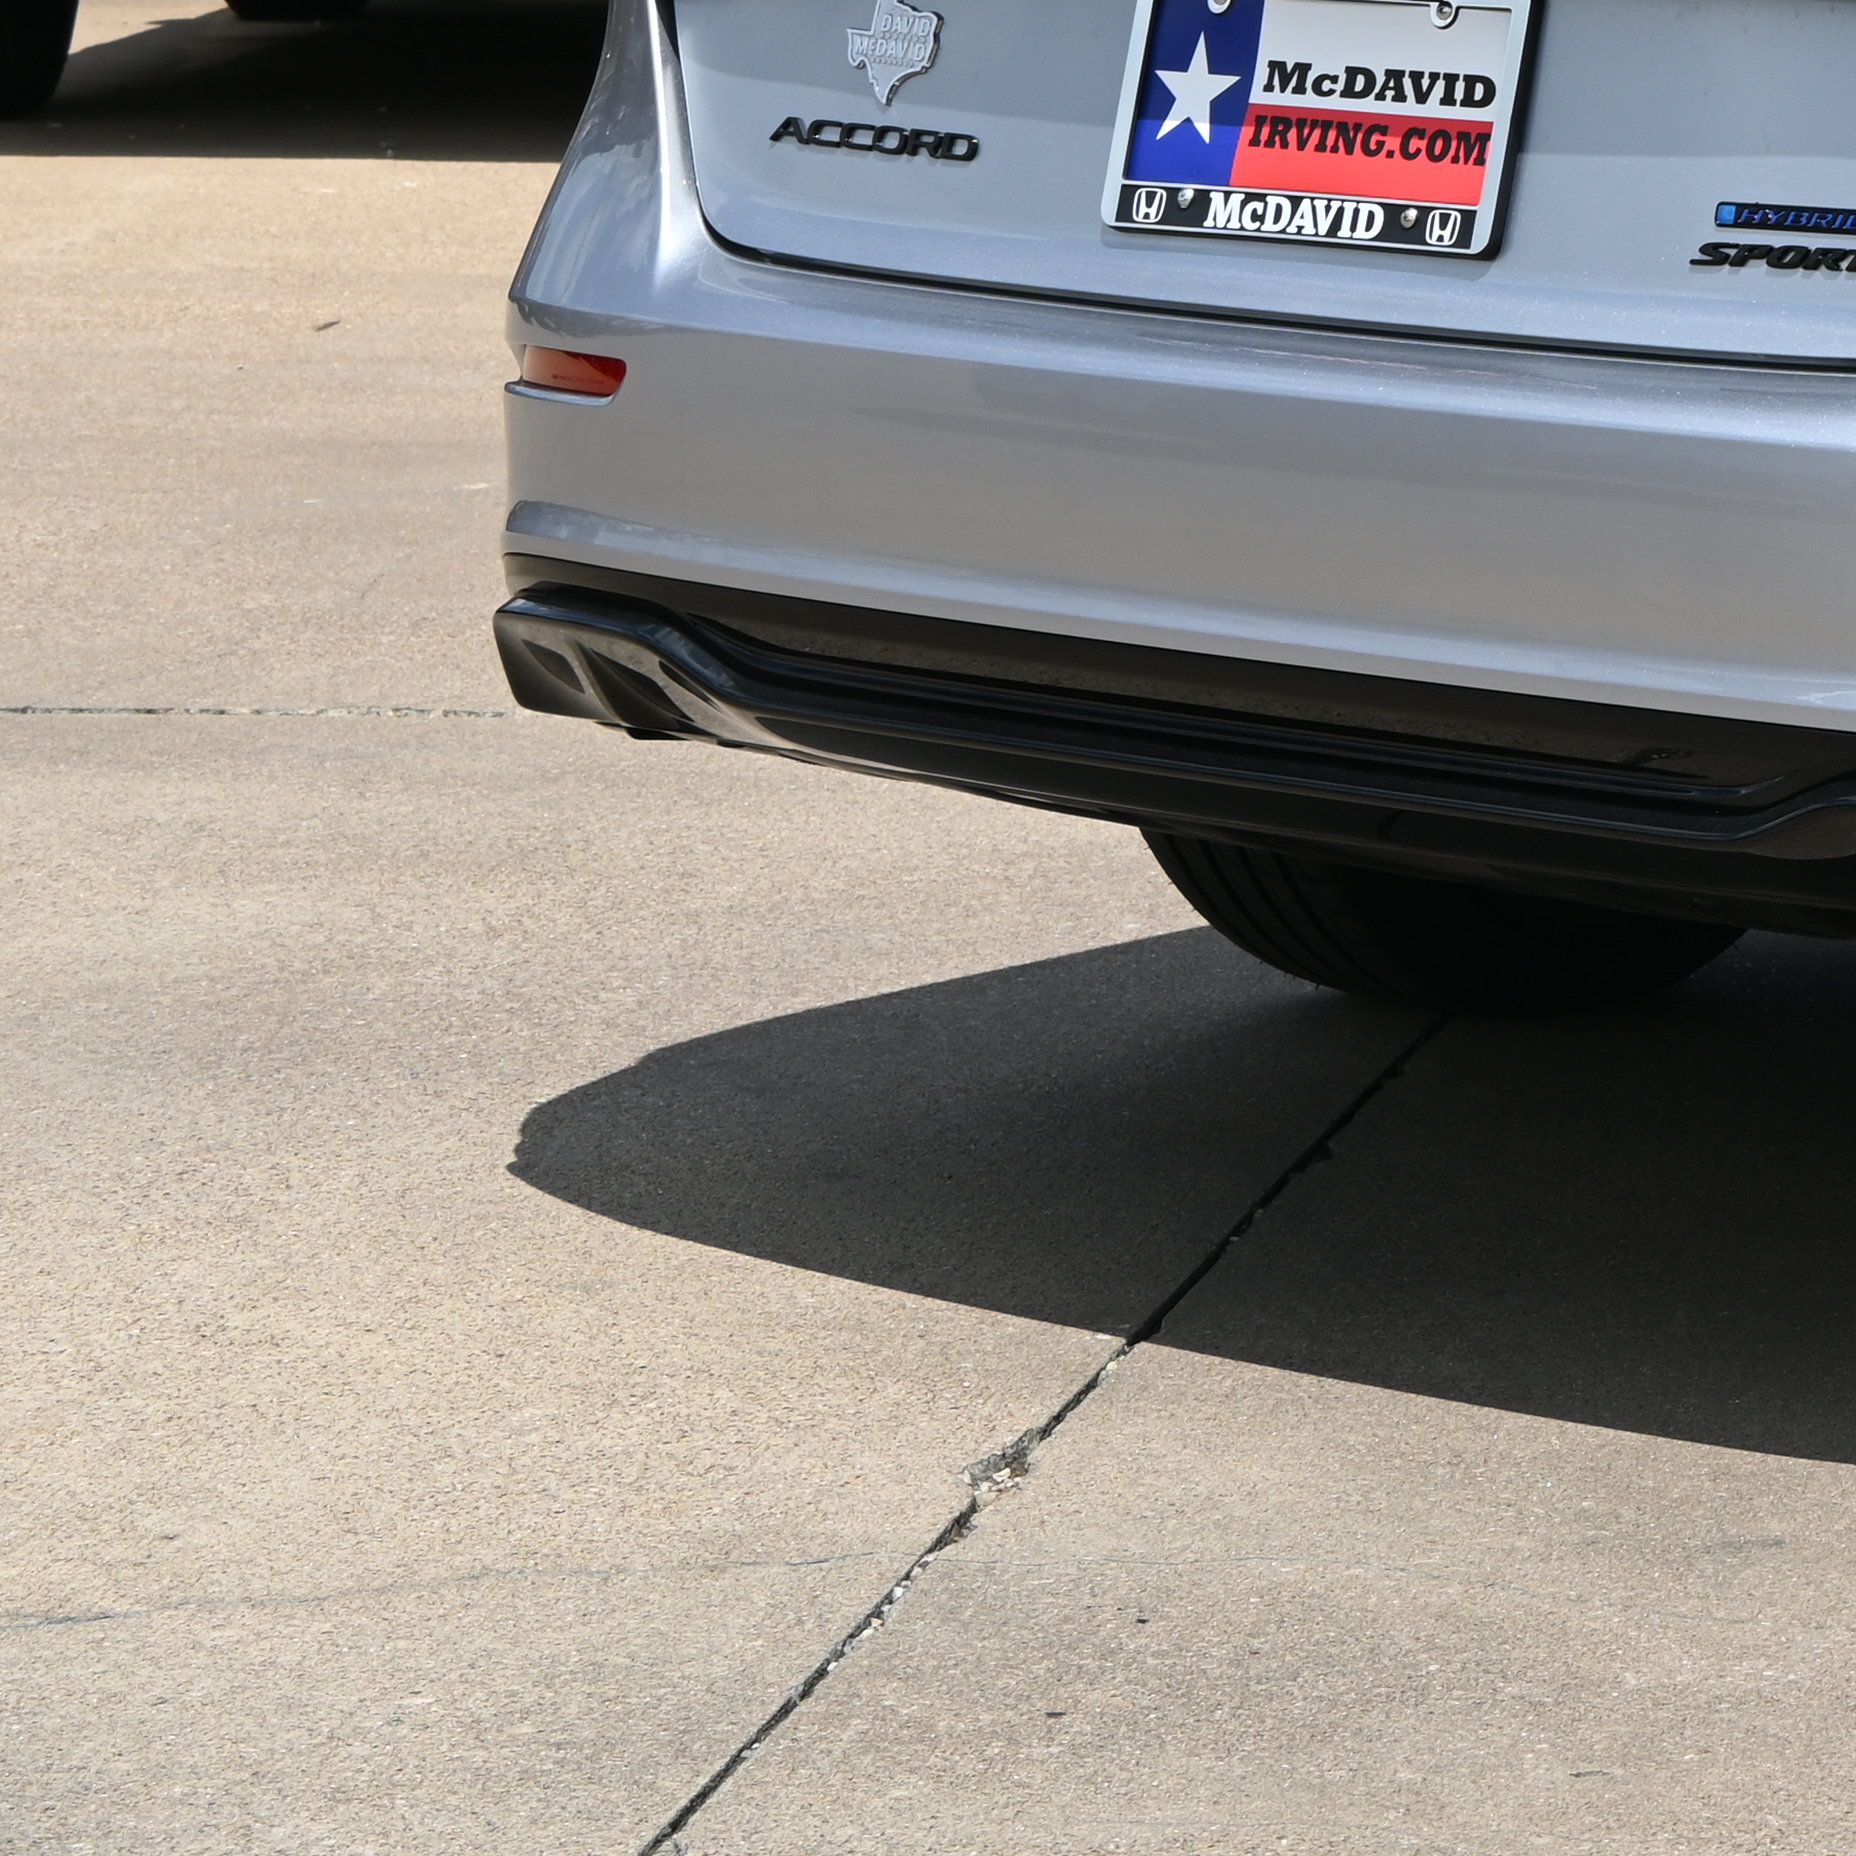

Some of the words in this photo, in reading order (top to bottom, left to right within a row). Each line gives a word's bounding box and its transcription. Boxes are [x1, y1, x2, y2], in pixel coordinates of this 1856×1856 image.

[854, 35, 925, 61] McDAVID
[882, 14, 930, 36] DAVID
[1262, 60, 1496, 109] McDAVID
[769, 115, 980, 162] ACCORD
[1248, 115, 1491, 167] IRVING.COM
[1203, 192, 1385, 240] McDAVID
